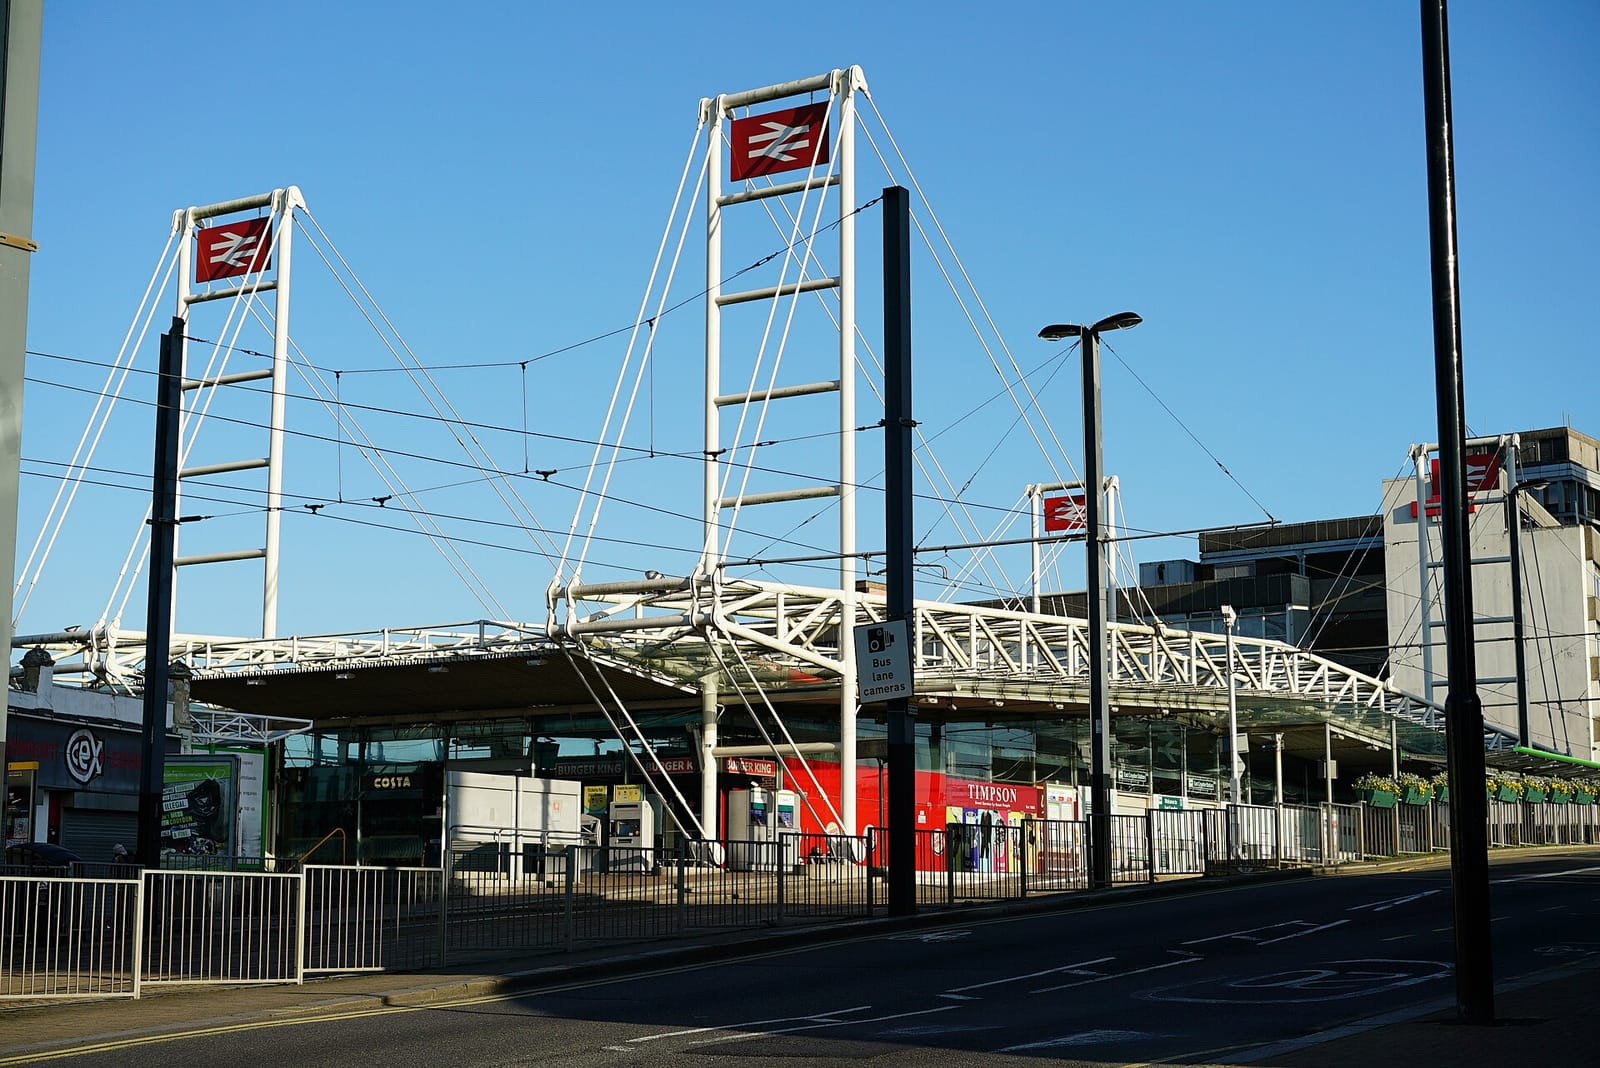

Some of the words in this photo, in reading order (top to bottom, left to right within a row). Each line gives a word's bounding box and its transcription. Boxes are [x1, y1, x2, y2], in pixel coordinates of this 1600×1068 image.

[873, 658, 892, 668] Bus
[872, 671, 894, 682] lane
[863, 683, 906, 696] cameras
[558, 764, 596, 776] BURGER
[597, 763, 622, 774] KING
[727, 759, 754, 772] BURGER
[754, 763, 772, 774] KING
[374, 776, 411, 789] COSTA
[968, 784, 1017, 803] TIMPSON
[165, 800, 187, 810] ILLEGAL
